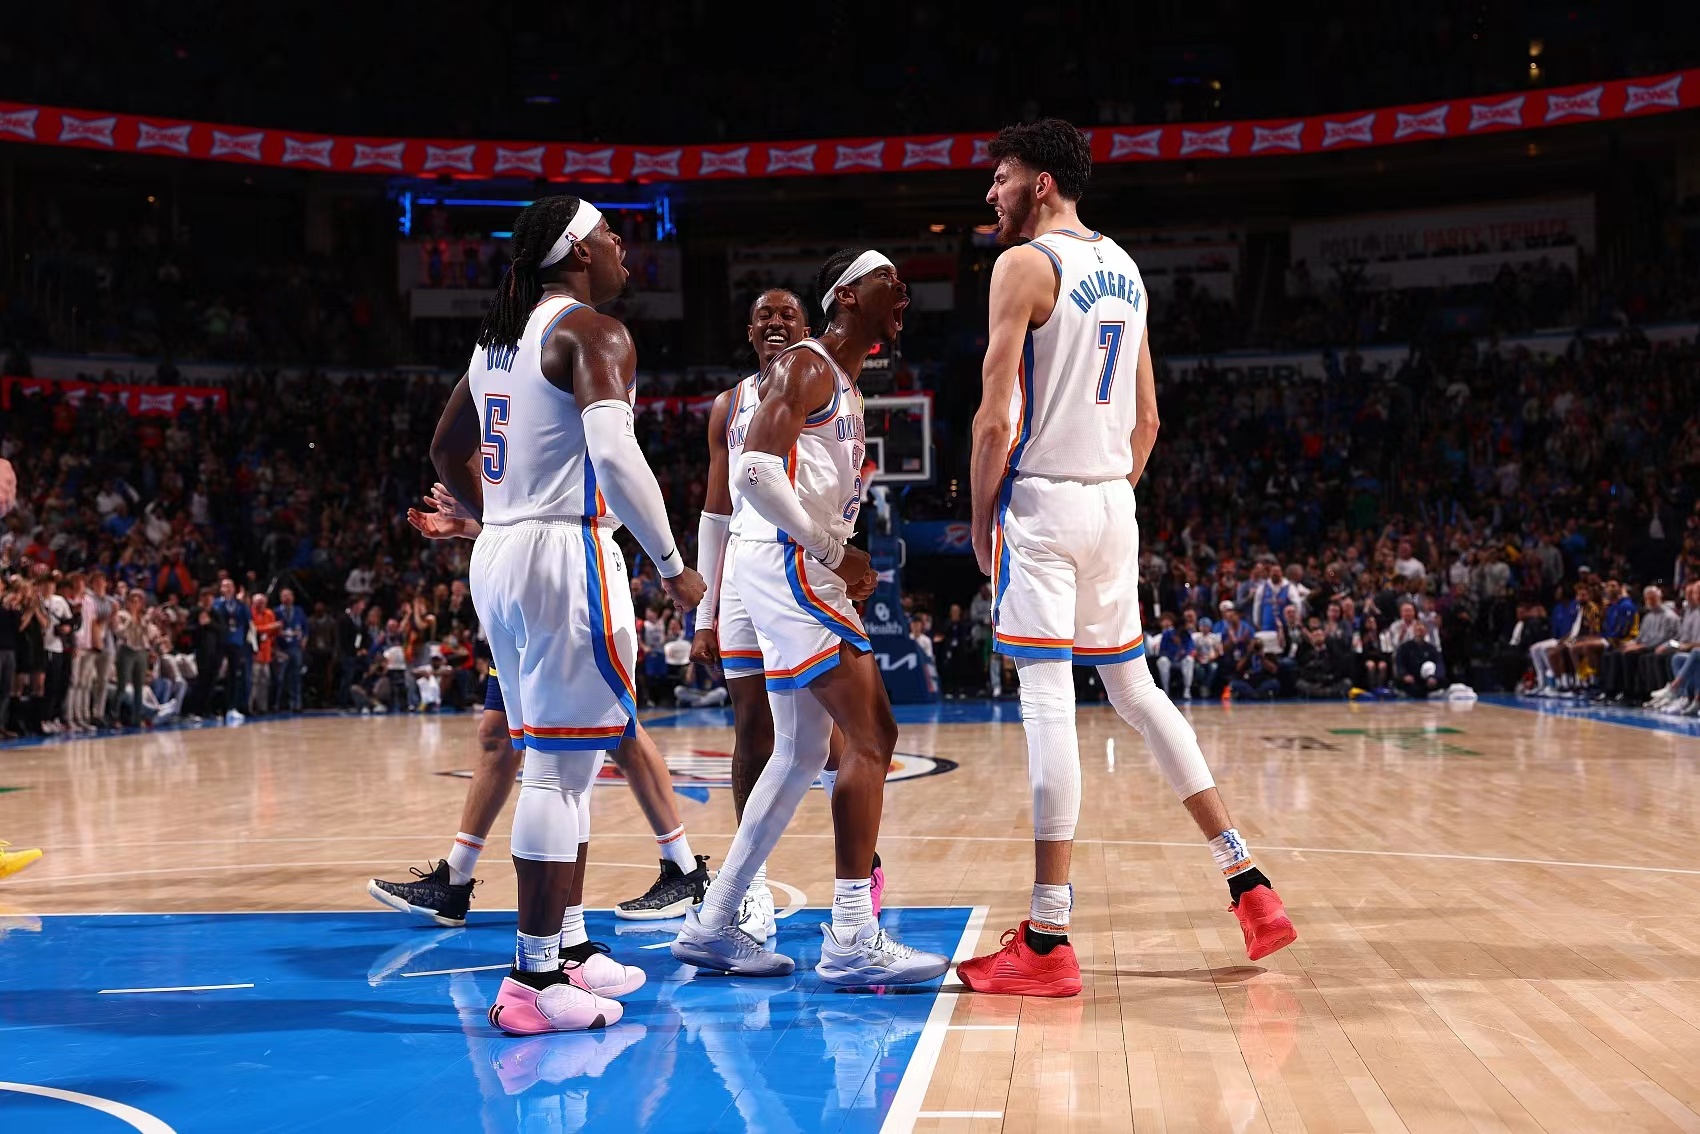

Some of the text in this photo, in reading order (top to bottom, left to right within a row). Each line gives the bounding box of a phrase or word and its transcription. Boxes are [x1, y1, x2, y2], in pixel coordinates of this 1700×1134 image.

[1070, 270, 1141, 313] HOLMGREN
[1096, 321, 1125, 404] 7
[481, 393, 510, 484] 5
